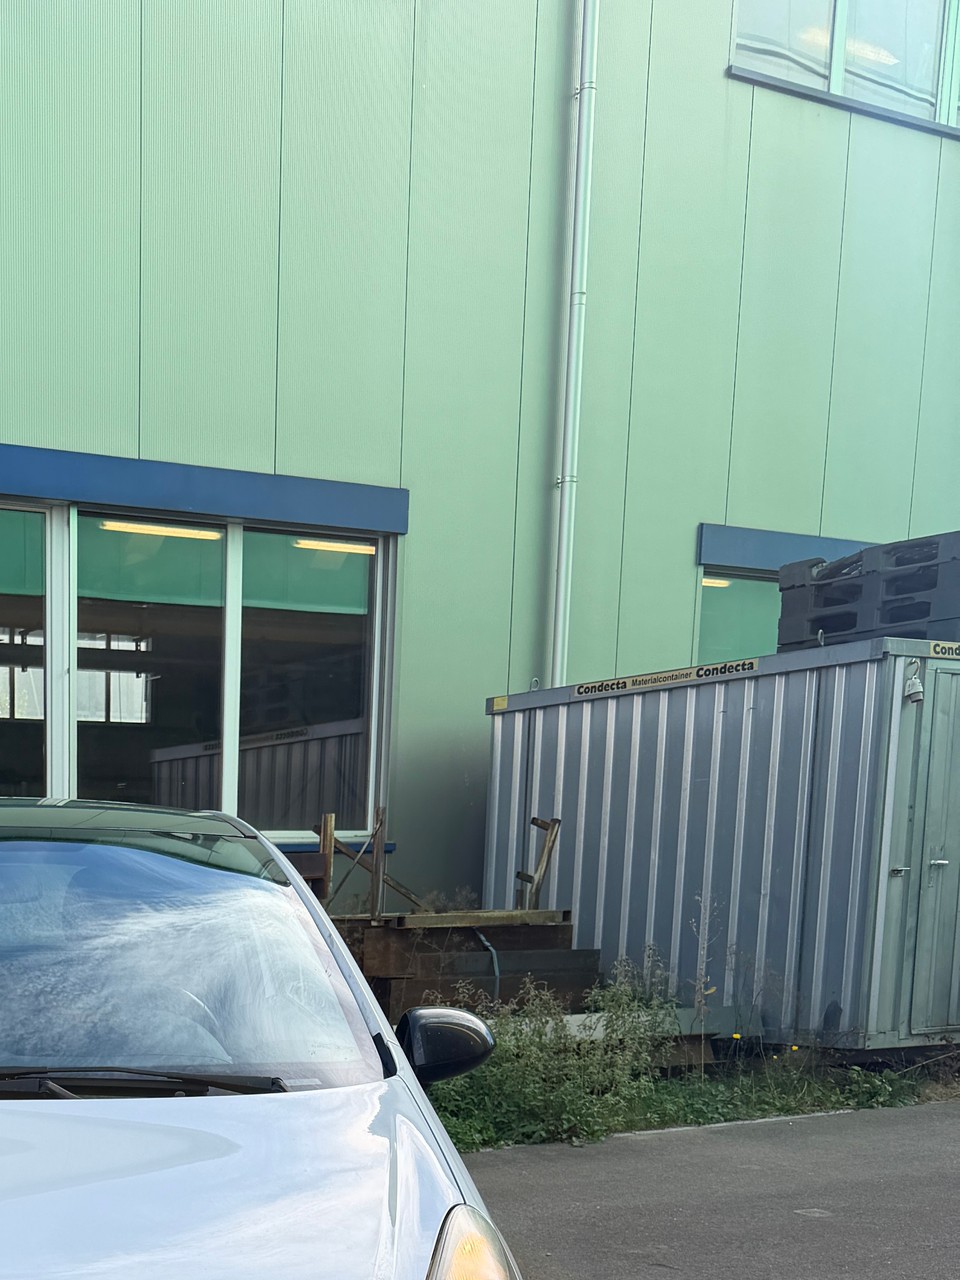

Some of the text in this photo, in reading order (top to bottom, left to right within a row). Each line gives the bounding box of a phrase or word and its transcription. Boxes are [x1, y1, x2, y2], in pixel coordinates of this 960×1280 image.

[577, 660, 754, 695] Condecta Materialcontainer Condecta
